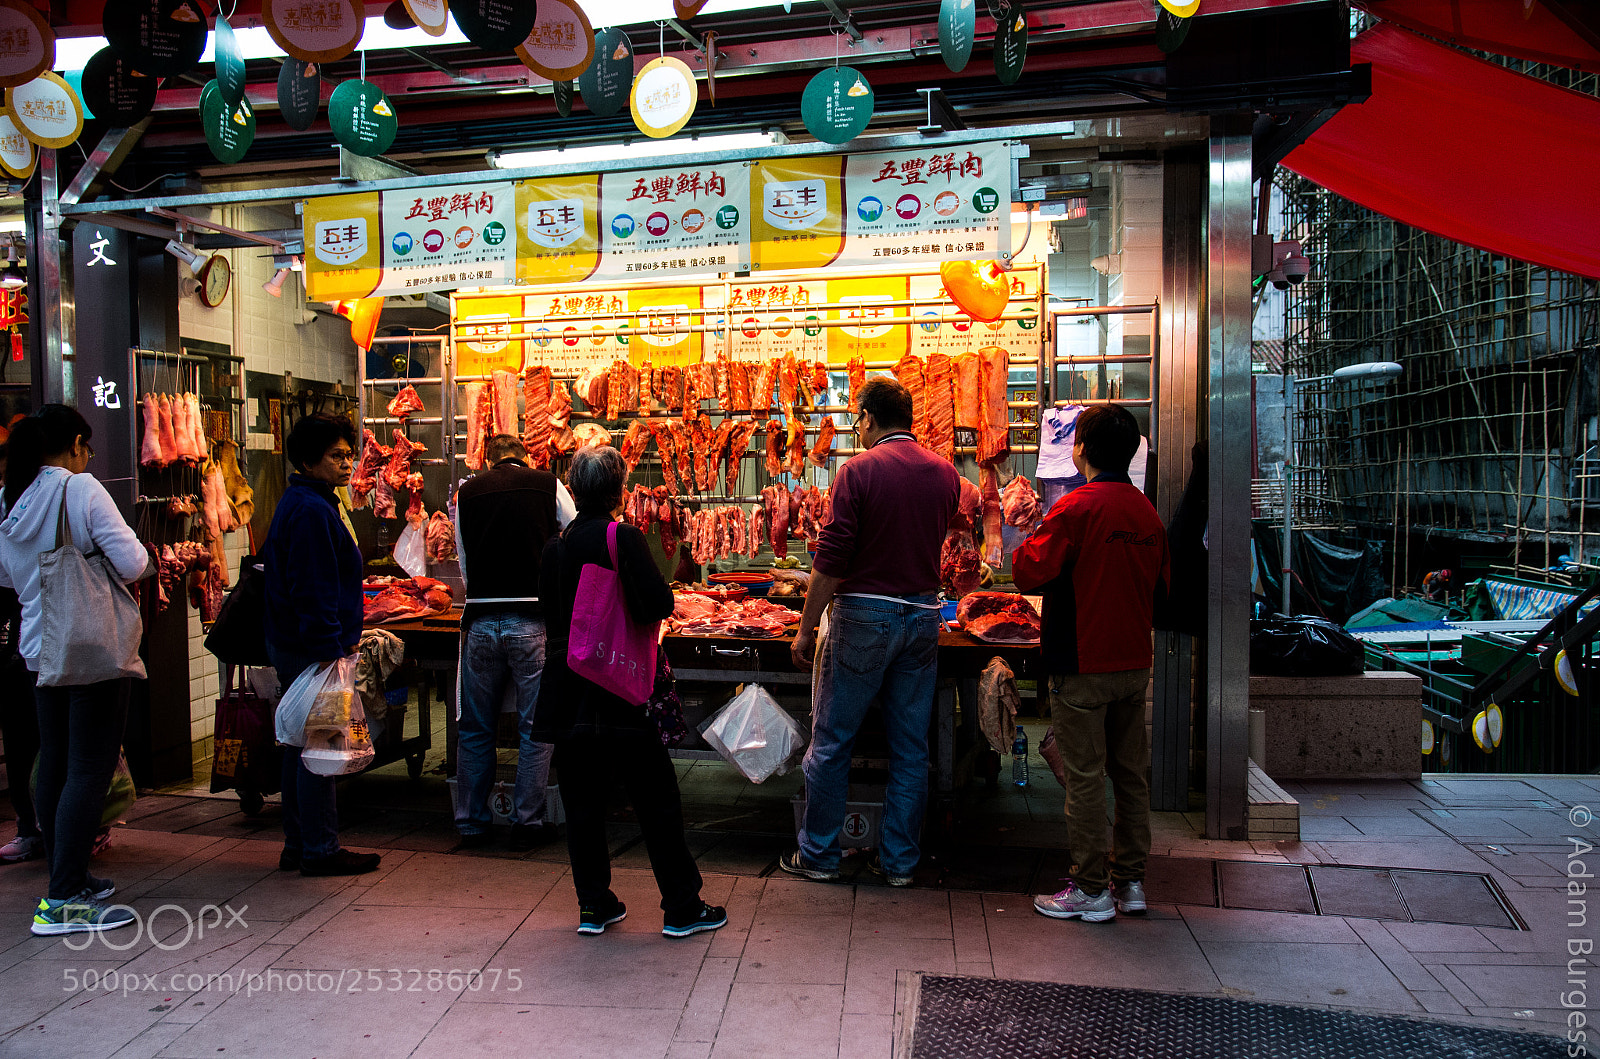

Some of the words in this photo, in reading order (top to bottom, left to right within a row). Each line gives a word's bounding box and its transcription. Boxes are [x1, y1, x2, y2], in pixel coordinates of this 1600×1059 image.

[872, 151, 983, 186] 五豐鮮肉
[626, 170, 726, 205] 五豐鮮肉
[772, 187, 817, 208] 五丰
[404, 191, 494, 223] 五豐鮮肉
[536, 206, 575, 227] 五丰
[323, 225, 360, 245] 五丰
[873, 244, 941, 257] 五豐60多年經驗
[945, 241, 985, 253] 信心保證
[625, 258, 687, 272] 五豐60多年經驗
[690, 255, 726, 267] 信心保證
[405, 273, 457, 287] 五豐60多年經驗
[459, 270, 493, 281] 信心保證
[549, 295, 624, 316] 五豐鮮肉
[731, 285, 810, 307] 五豐鮮肉
